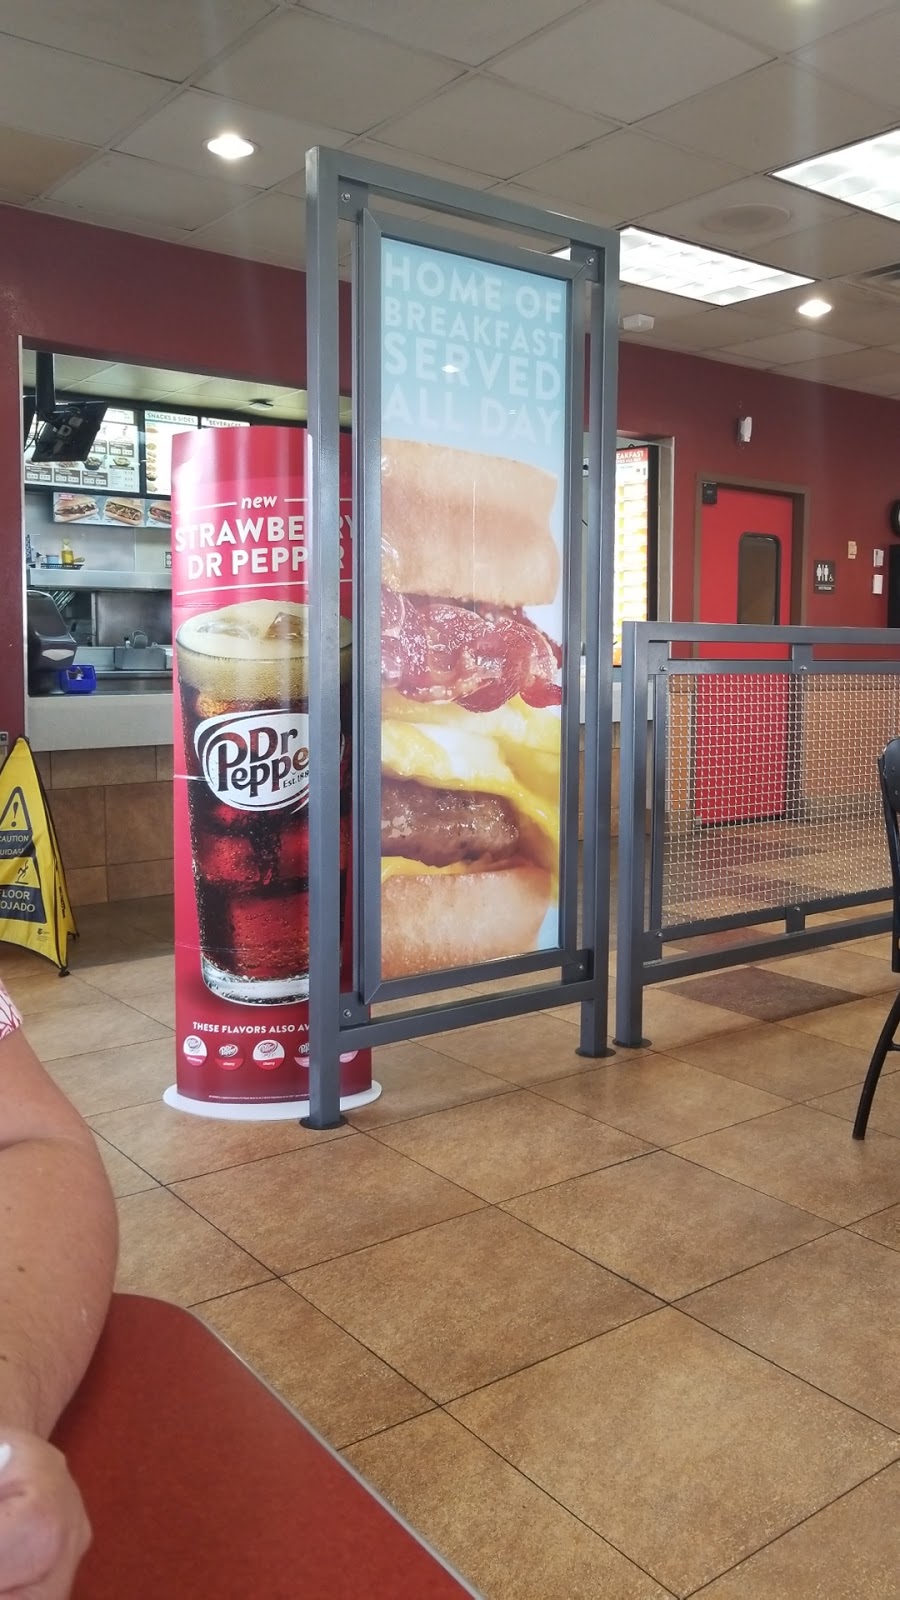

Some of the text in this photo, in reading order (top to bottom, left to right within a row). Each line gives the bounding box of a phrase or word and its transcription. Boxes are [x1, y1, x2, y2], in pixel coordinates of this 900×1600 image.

[384, 252, 562, 324] HOME OF
[384, 296, 563, 359] BREAKFAST
[384, 332, 562, 401] SERVED
[147, 413, 171, 421] SNACKS
[384, 382, 561, 448] ALL DAY
[616, 451, 644, 460] EAKFAST
[241, 495, 278, 509] new
[175, 515, 353, 552] STRAWBEY
[188, 547, 345, 580] DR PEPP
[206, 727, 310, 798] Dr Peppe
[297, 770, 310, 782] 188
[0, 901, 36, 913] OJADO
[193, 1021, 219, 1033] THESE
[222, 1025, 266, 1034] FLAVORS
[268, 1024, 296, 1033] ALSO
